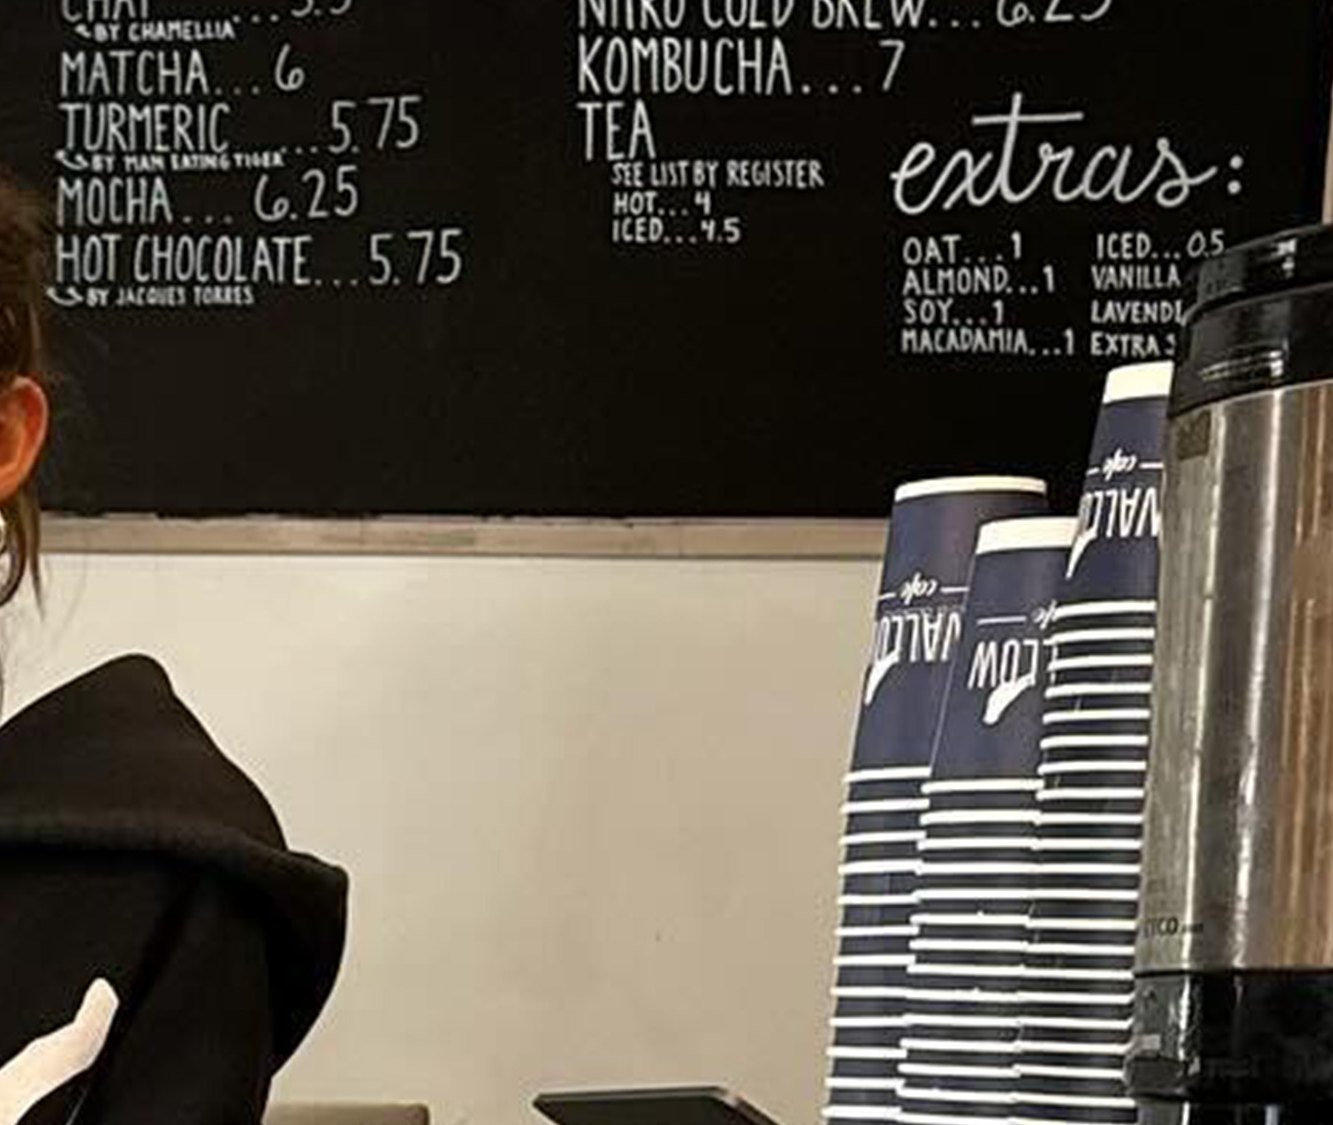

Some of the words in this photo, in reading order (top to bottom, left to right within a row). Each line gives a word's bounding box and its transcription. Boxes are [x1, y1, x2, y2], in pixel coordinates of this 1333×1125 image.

[93, 22, 121, 41] BY
[129, 20, 235, 41] CHAMELLIA
[274, 43, 305, 91] 6
[879, 38, 906, 91] 7
[329, 96, 421, 153] 5.75
[576, 99, 656, 161] TEA
[91, 153, 114, 172] BY
[234, 149, 284, 169] TIGER
[611, 161, 644, 188] SEE
[650, 160, 689, 188] LIST
[692, 160, 719, 188] BY
[726, 160, 825, 188] REGISTER
[254, 165, 359, 222] 6.25
[694, 191, 711, 216] 4
[700, 217, 741, 243] 4.5
[56, 233, 121, 284] HOT
[369, 228, 464, 287] 5.75
[1011, 230, 1022, 260] 1
[1043, 264, 1055, 293] 1
[1091, 263, 1182, 291] VANILLA
[86, 288, 109, 307] BY
[193, 286, 254, 305] TORRES
[993, 299, 1004, 325] 1
[1064, 327, 1074, 355] 1
[1091, 331, 1160, 358] EXTRA
